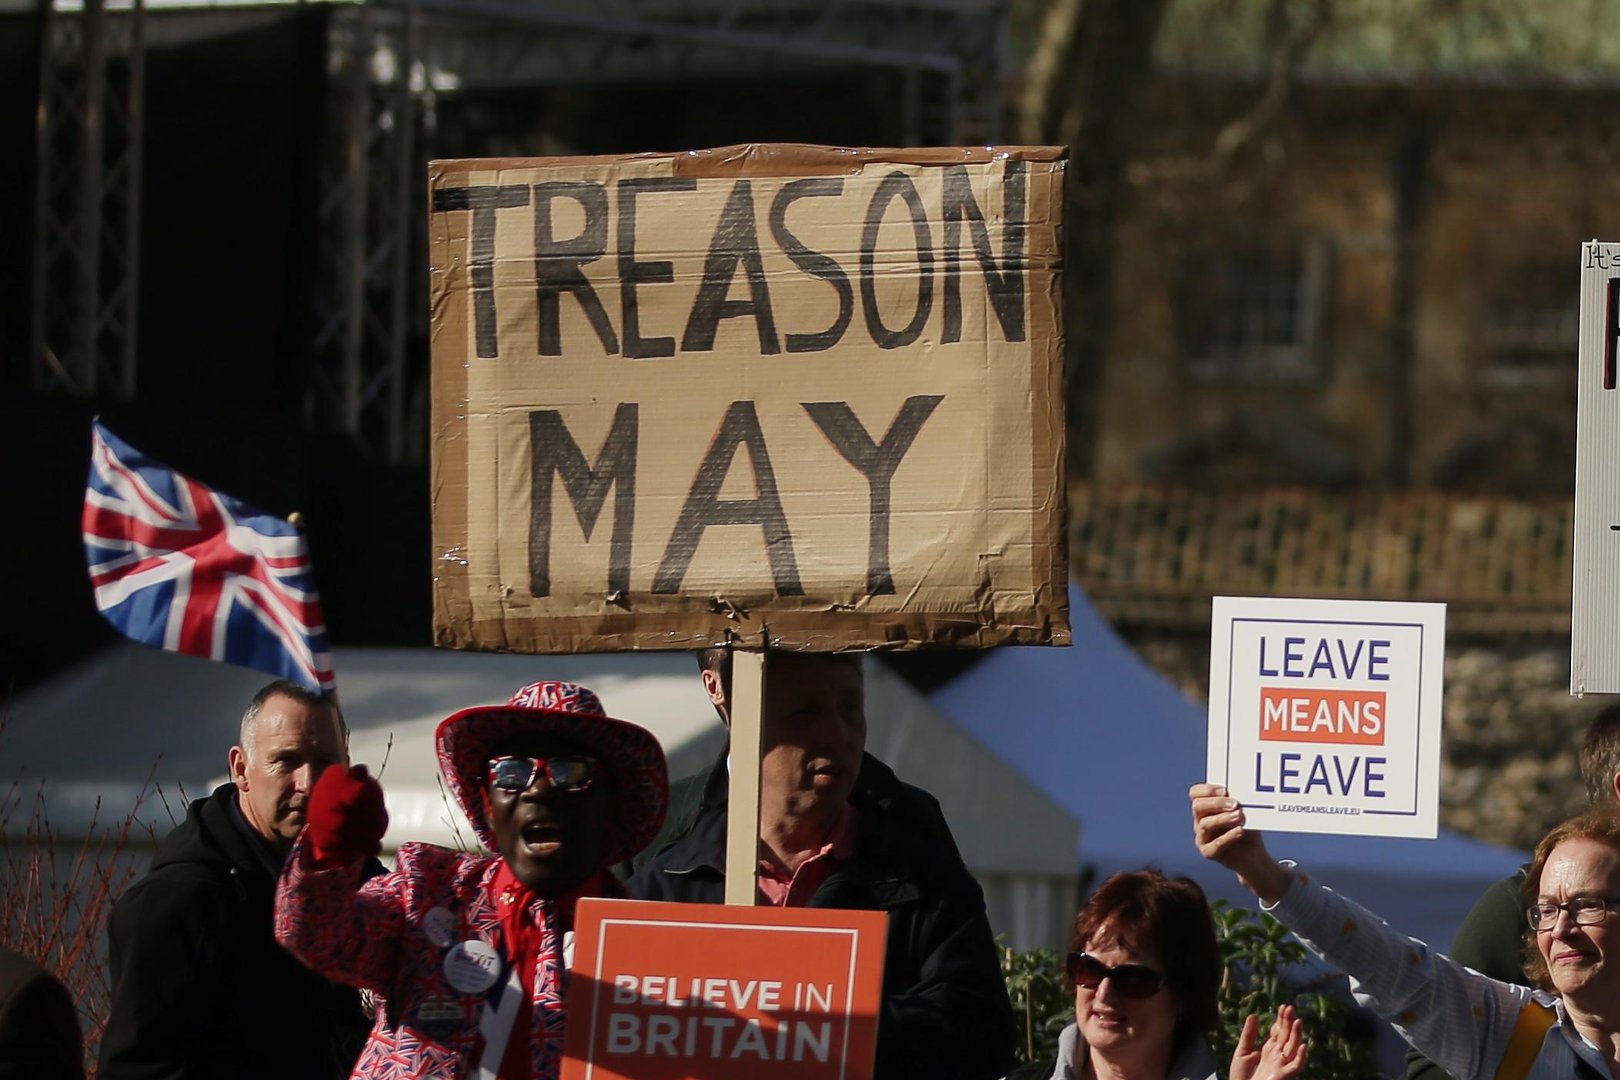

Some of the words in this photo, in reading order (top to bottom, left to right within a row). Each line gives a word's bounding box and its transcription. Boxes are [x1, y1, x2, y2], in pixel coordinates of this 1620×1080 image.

[433, 159, 1026, 358] TREASON
[528, 394, 945, 597] MAY
[1259, 636, 1391, 681] LEAVE
[1263, 696, 1381, 736] MEANS
[1255, 751, 1387, 798] LEAVE
[1278, 804, 1360, 816] LEAVEMEANSLEAVE.EU
[613, 974, 783, 1011] BELIEVE
[794, 982, 833, 1013] IN
[606, 1012, 832, 1063] BRITAIN
